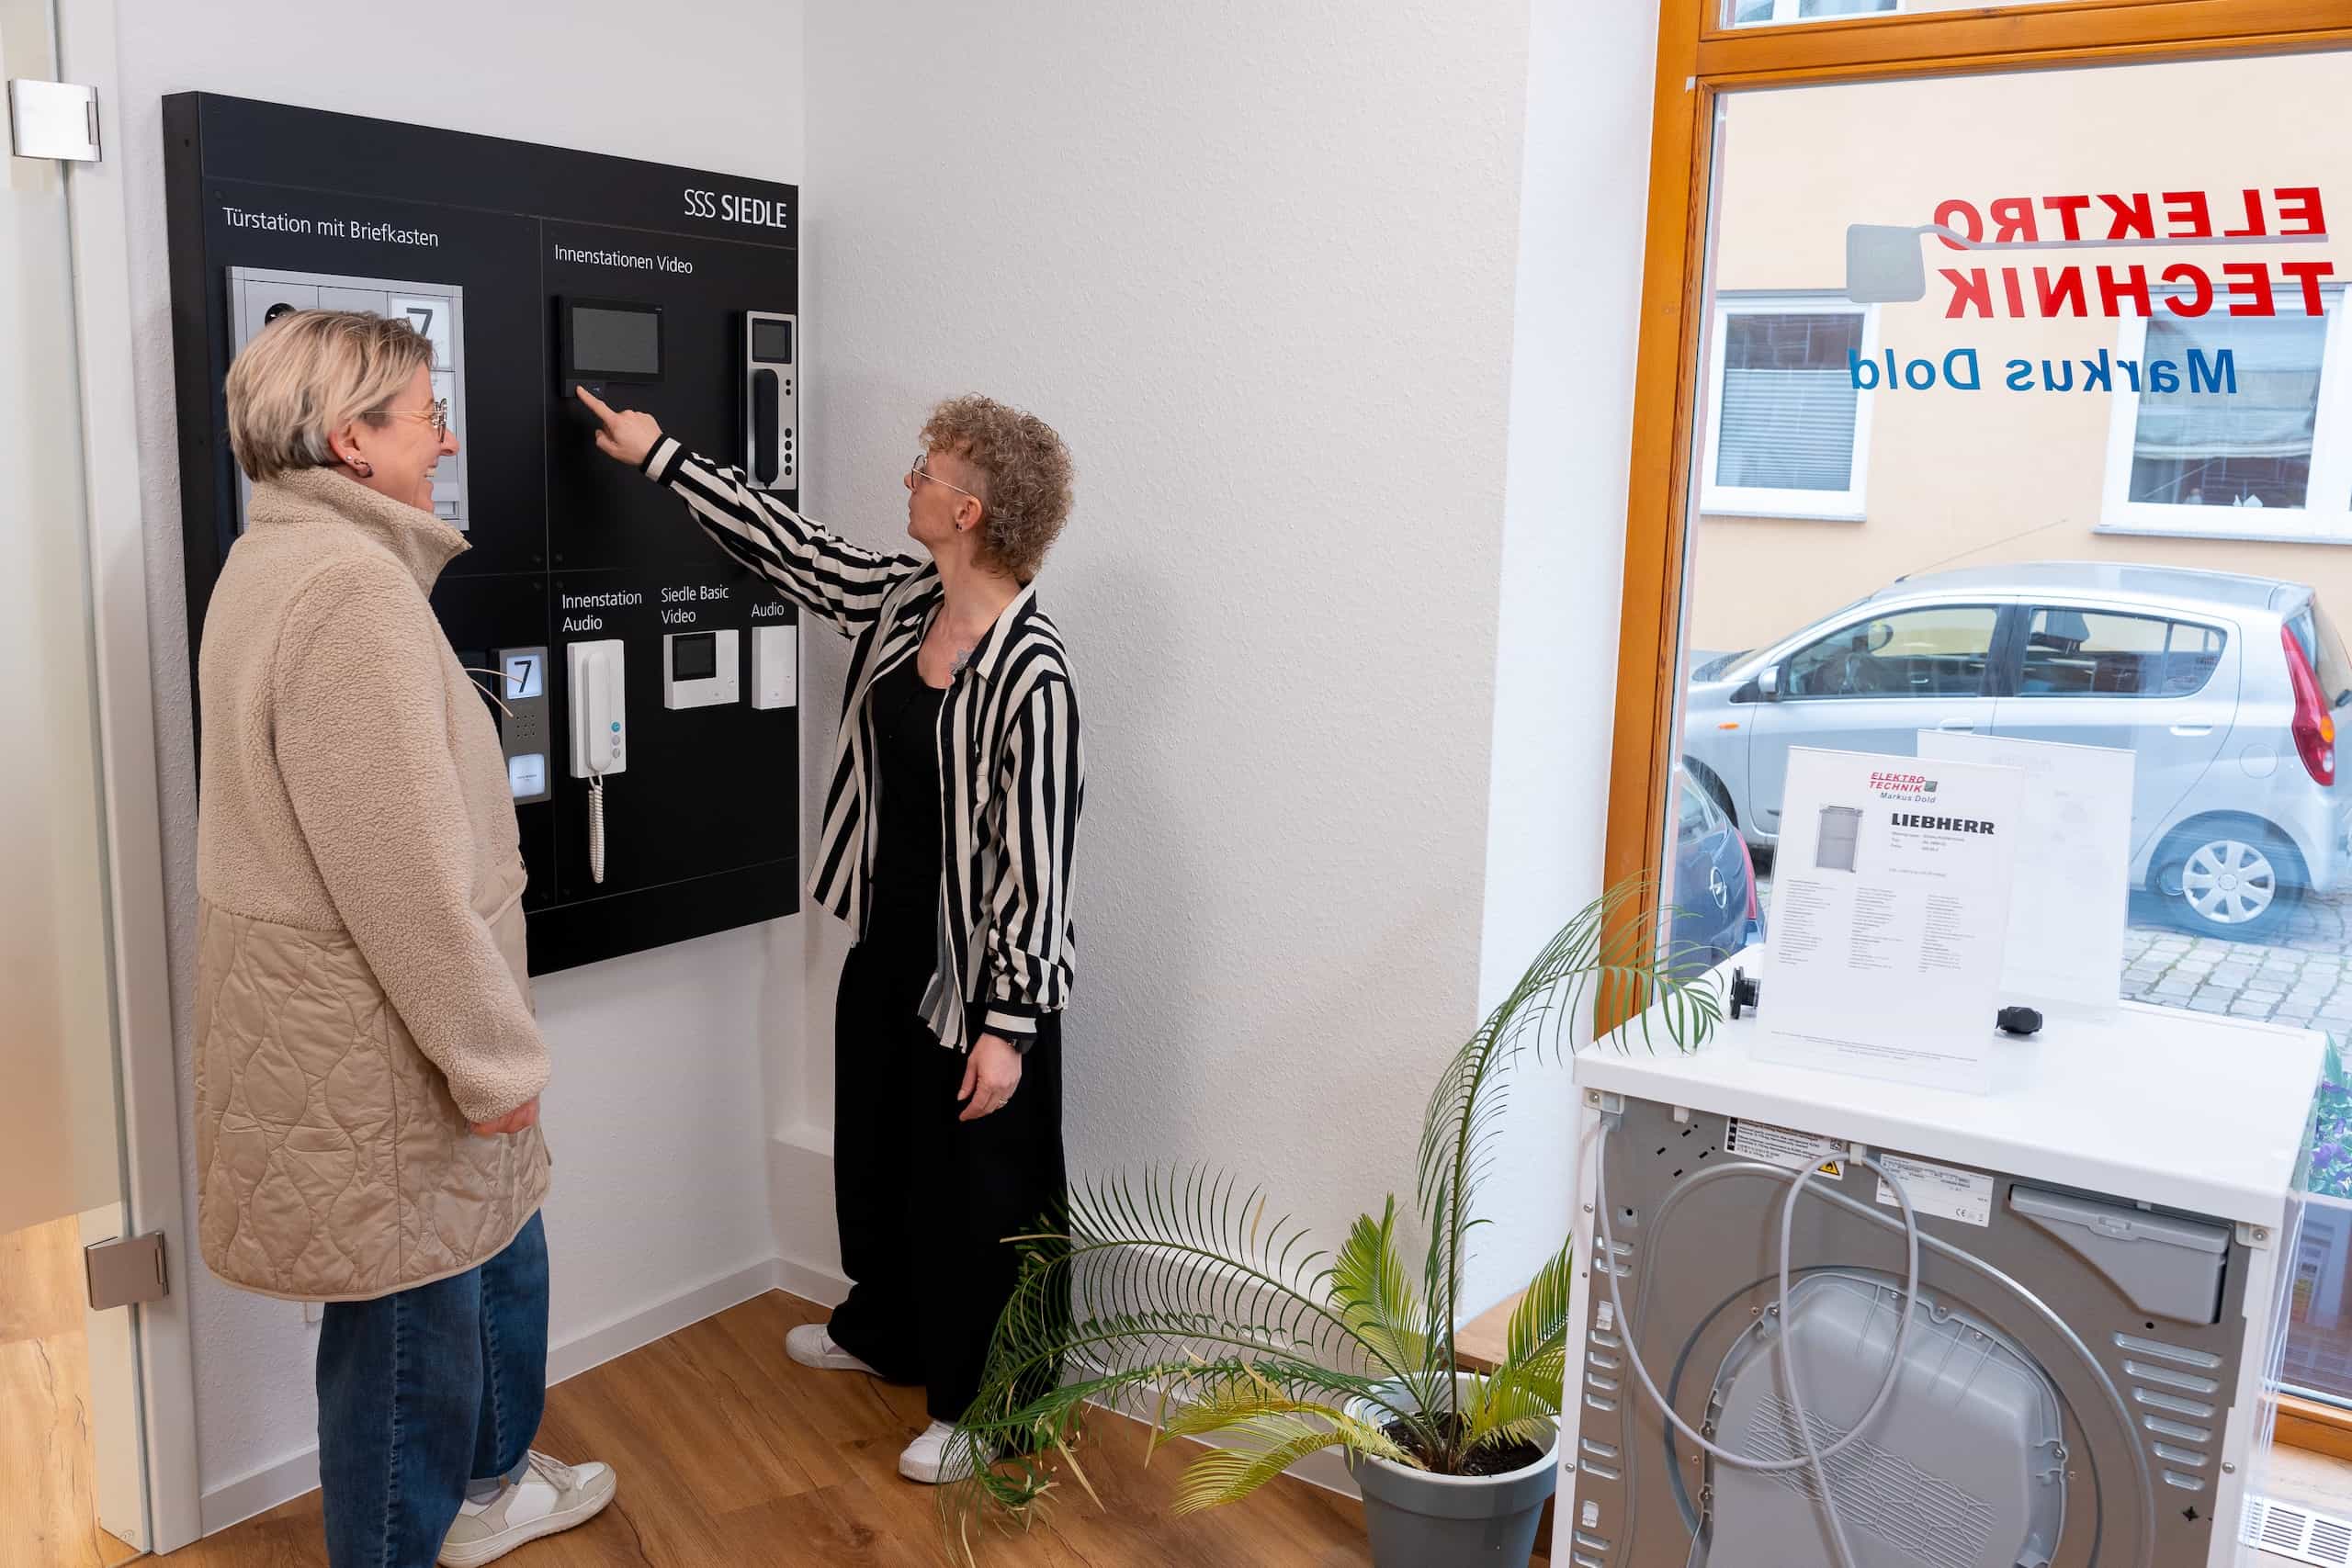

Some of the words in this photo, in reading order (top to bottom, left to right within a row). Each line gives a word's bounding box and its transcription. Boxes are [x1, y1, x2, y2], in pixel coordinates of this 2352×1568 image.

[720, 194, 788, 229] SIEDLE
[222, 207, 311, 234] Türstation
[317, 218, 345, 238] mit
[350, 220, 439, 247] Briefkasten
[554, 243, 653, 270] Innenstationen
[656, 255, 694, 274] Video
[561, 590, 642, 609] Innenstation
[661, 585, 697, 603] Siedle
[700, 583, 729, 600] Basic
[661, 608, 696, 625] Video
[751, 602, 785, 618] Audio
[562, 614, 603, 633] Audio
[514, 660, 533, 694] 7
[1869, 781, 1922, 793] TECHNIK
[1871, 772, 1925, 784] ELEKTRO
[1881, 792, 1912, 801] Markus
[1915, 795, 1936, 803] Dold
[1891, 812, 1996, 835] LIEBHERR
